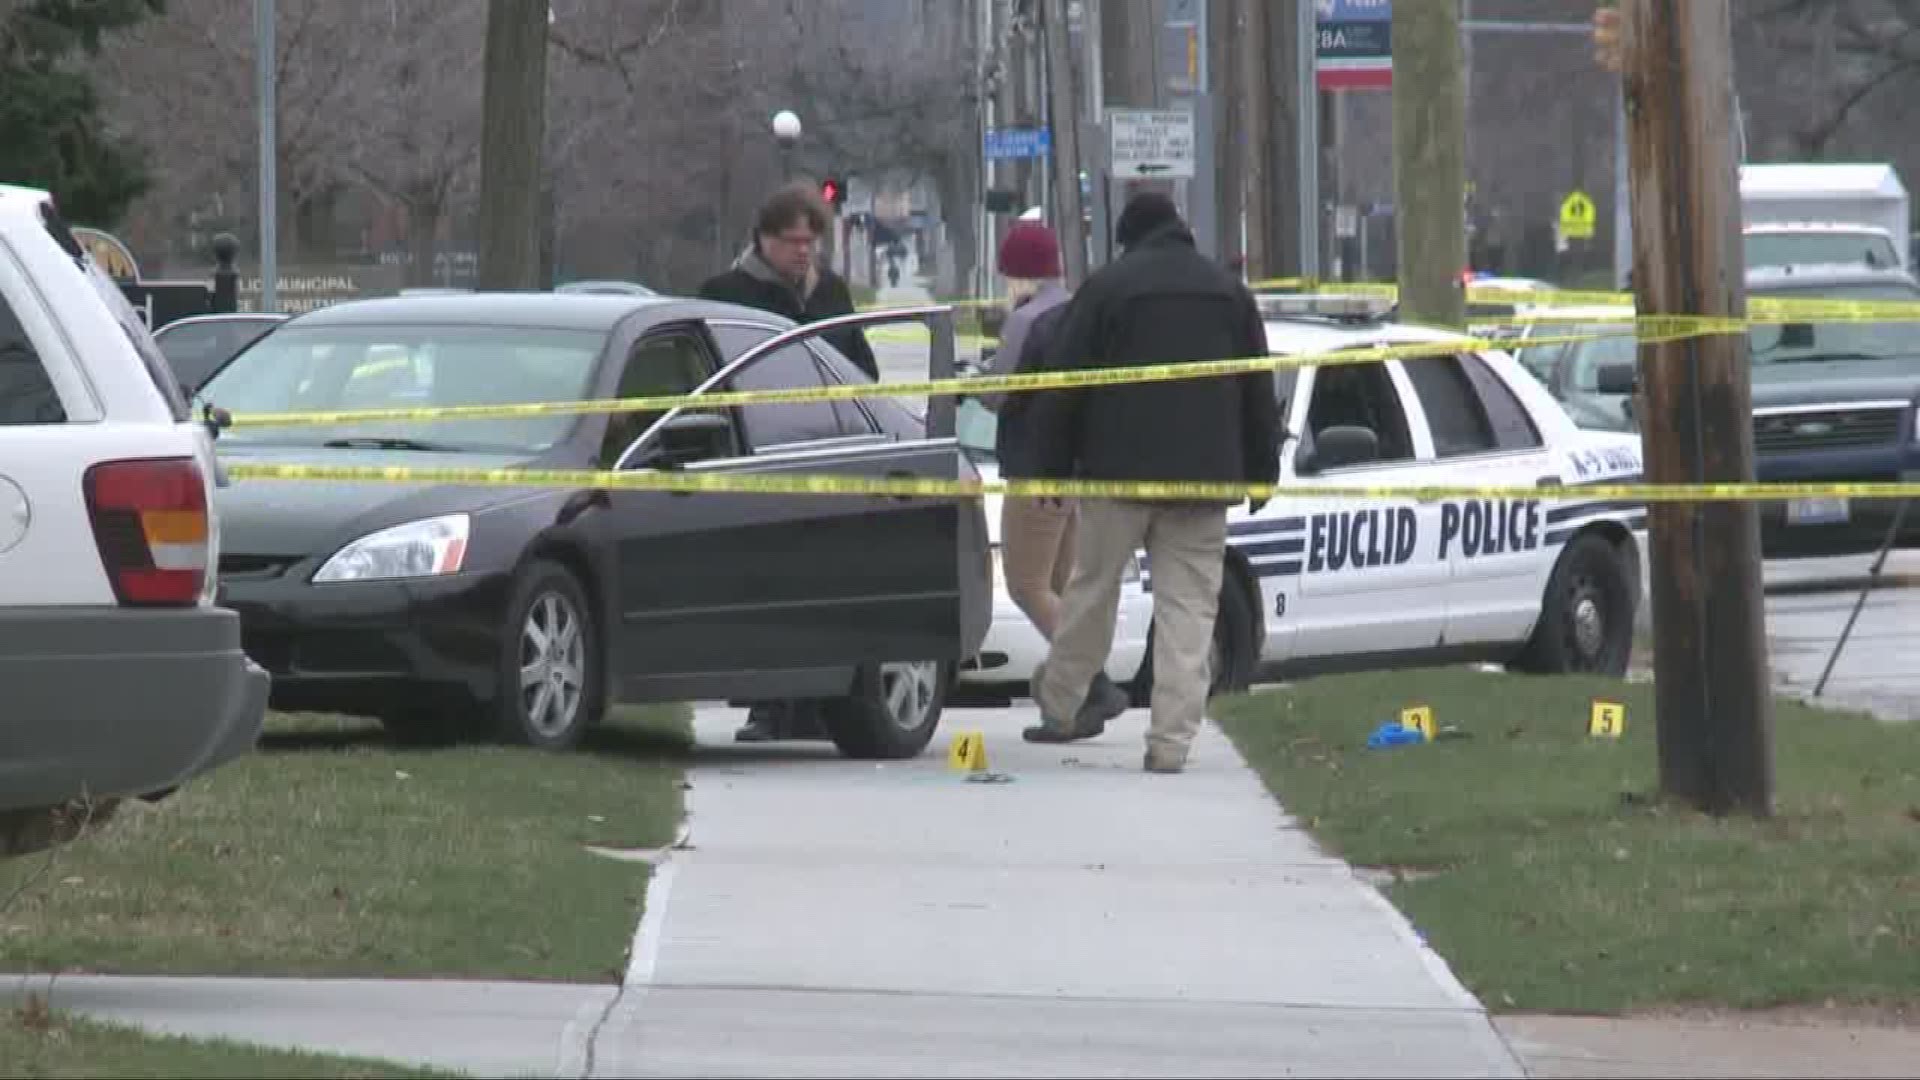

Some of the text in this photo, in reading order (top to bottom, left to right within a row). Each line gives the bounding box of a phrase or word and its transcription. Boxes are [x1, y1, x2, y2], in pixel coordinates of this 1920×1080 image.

[1307, 499, 1539, 573] EUCLID POLICE
[1275, 592, 1286, 617] 8
[1600, 708, 1614, 733] 5
[957, 737, 970, 762] 4
